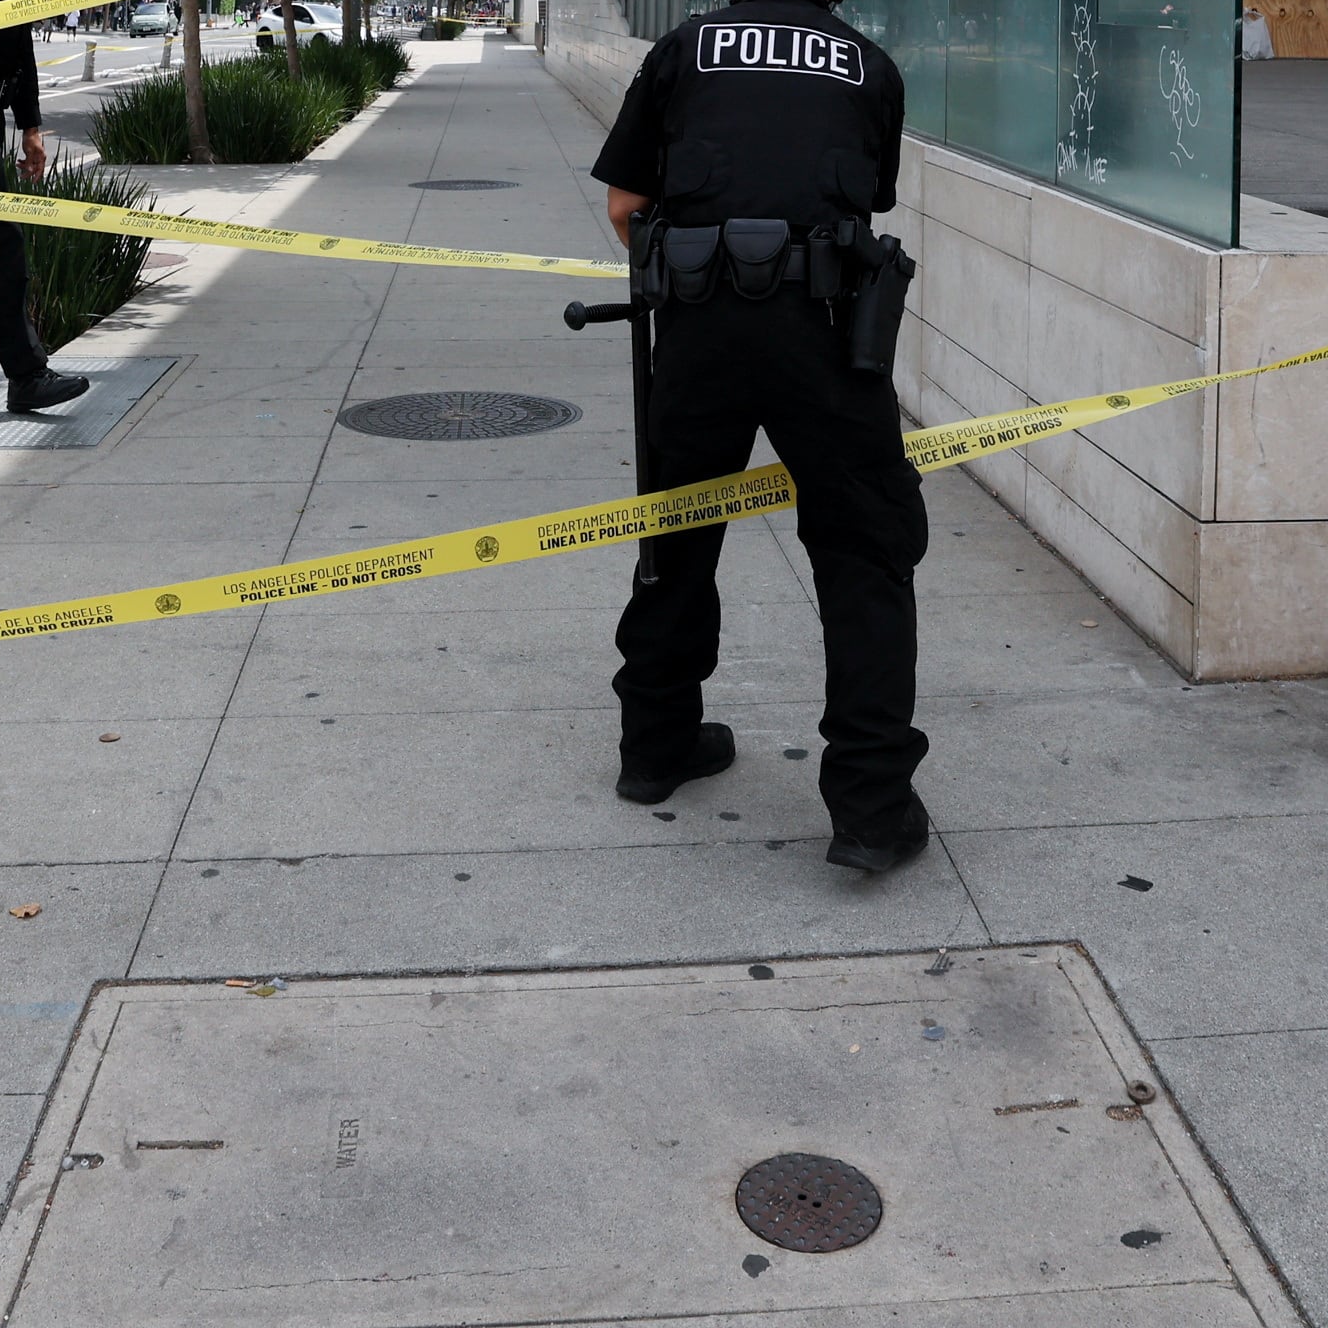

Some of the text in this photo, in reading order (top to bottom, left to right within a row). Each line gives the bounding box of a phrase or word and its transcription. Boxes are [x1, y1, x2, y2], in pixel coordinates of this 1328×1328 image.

[713, 28, 850, 76] POLICE
[8, 195, 30, 205] LINE
[8, 204, 44, 217] ANGELES
[27, 197, 57, 208] POLICE
[42, 205, 60, 218] LOS
[901, 405, 1069, 454] ANGELES POLICE DEPARTMENT
[901, 449, 941, 470] OLICE
[941, 440, 970, 460] LINE
[978, 434, 997, 449] DO
[996, 427, 1021, 444] NOT
[1023, 417, 1063, 436] CROSS
[537, 471, 792, 538] DEPARTAMENTO DE POLICIA DE LOS ANGELES
[539, 534, 577, 551] LINEA
[579, 529, 596, 544] DE
[598, 520, 647, 540] POLICIA
[658, 513, 683, 529] POR
[685, 504, 723, 523] FAVOR
[725, 499, 742, 515] NO
[744, 489, 791, 511] CRUZAR
[222, 547, 434, 596] LOS ANGELES POLICE DEPARTMENT
[240, 587, 286, 603] POLICE
[289, 581, 319, 595] LINE
[331, 576, 349, 589] DO
[351, 571, 377, 585] NOT
[380, 563, 422, 580] CROSS
[4, 617, 23, 629] DE
[25, 613, 51, 626] LOS
[54, 604, 113, 622] ANGELES
[38, 622, 58, 632] NO
[60, 614, 114, 629] CRUZAR
[336, 1119, 360, 1169] WATER
